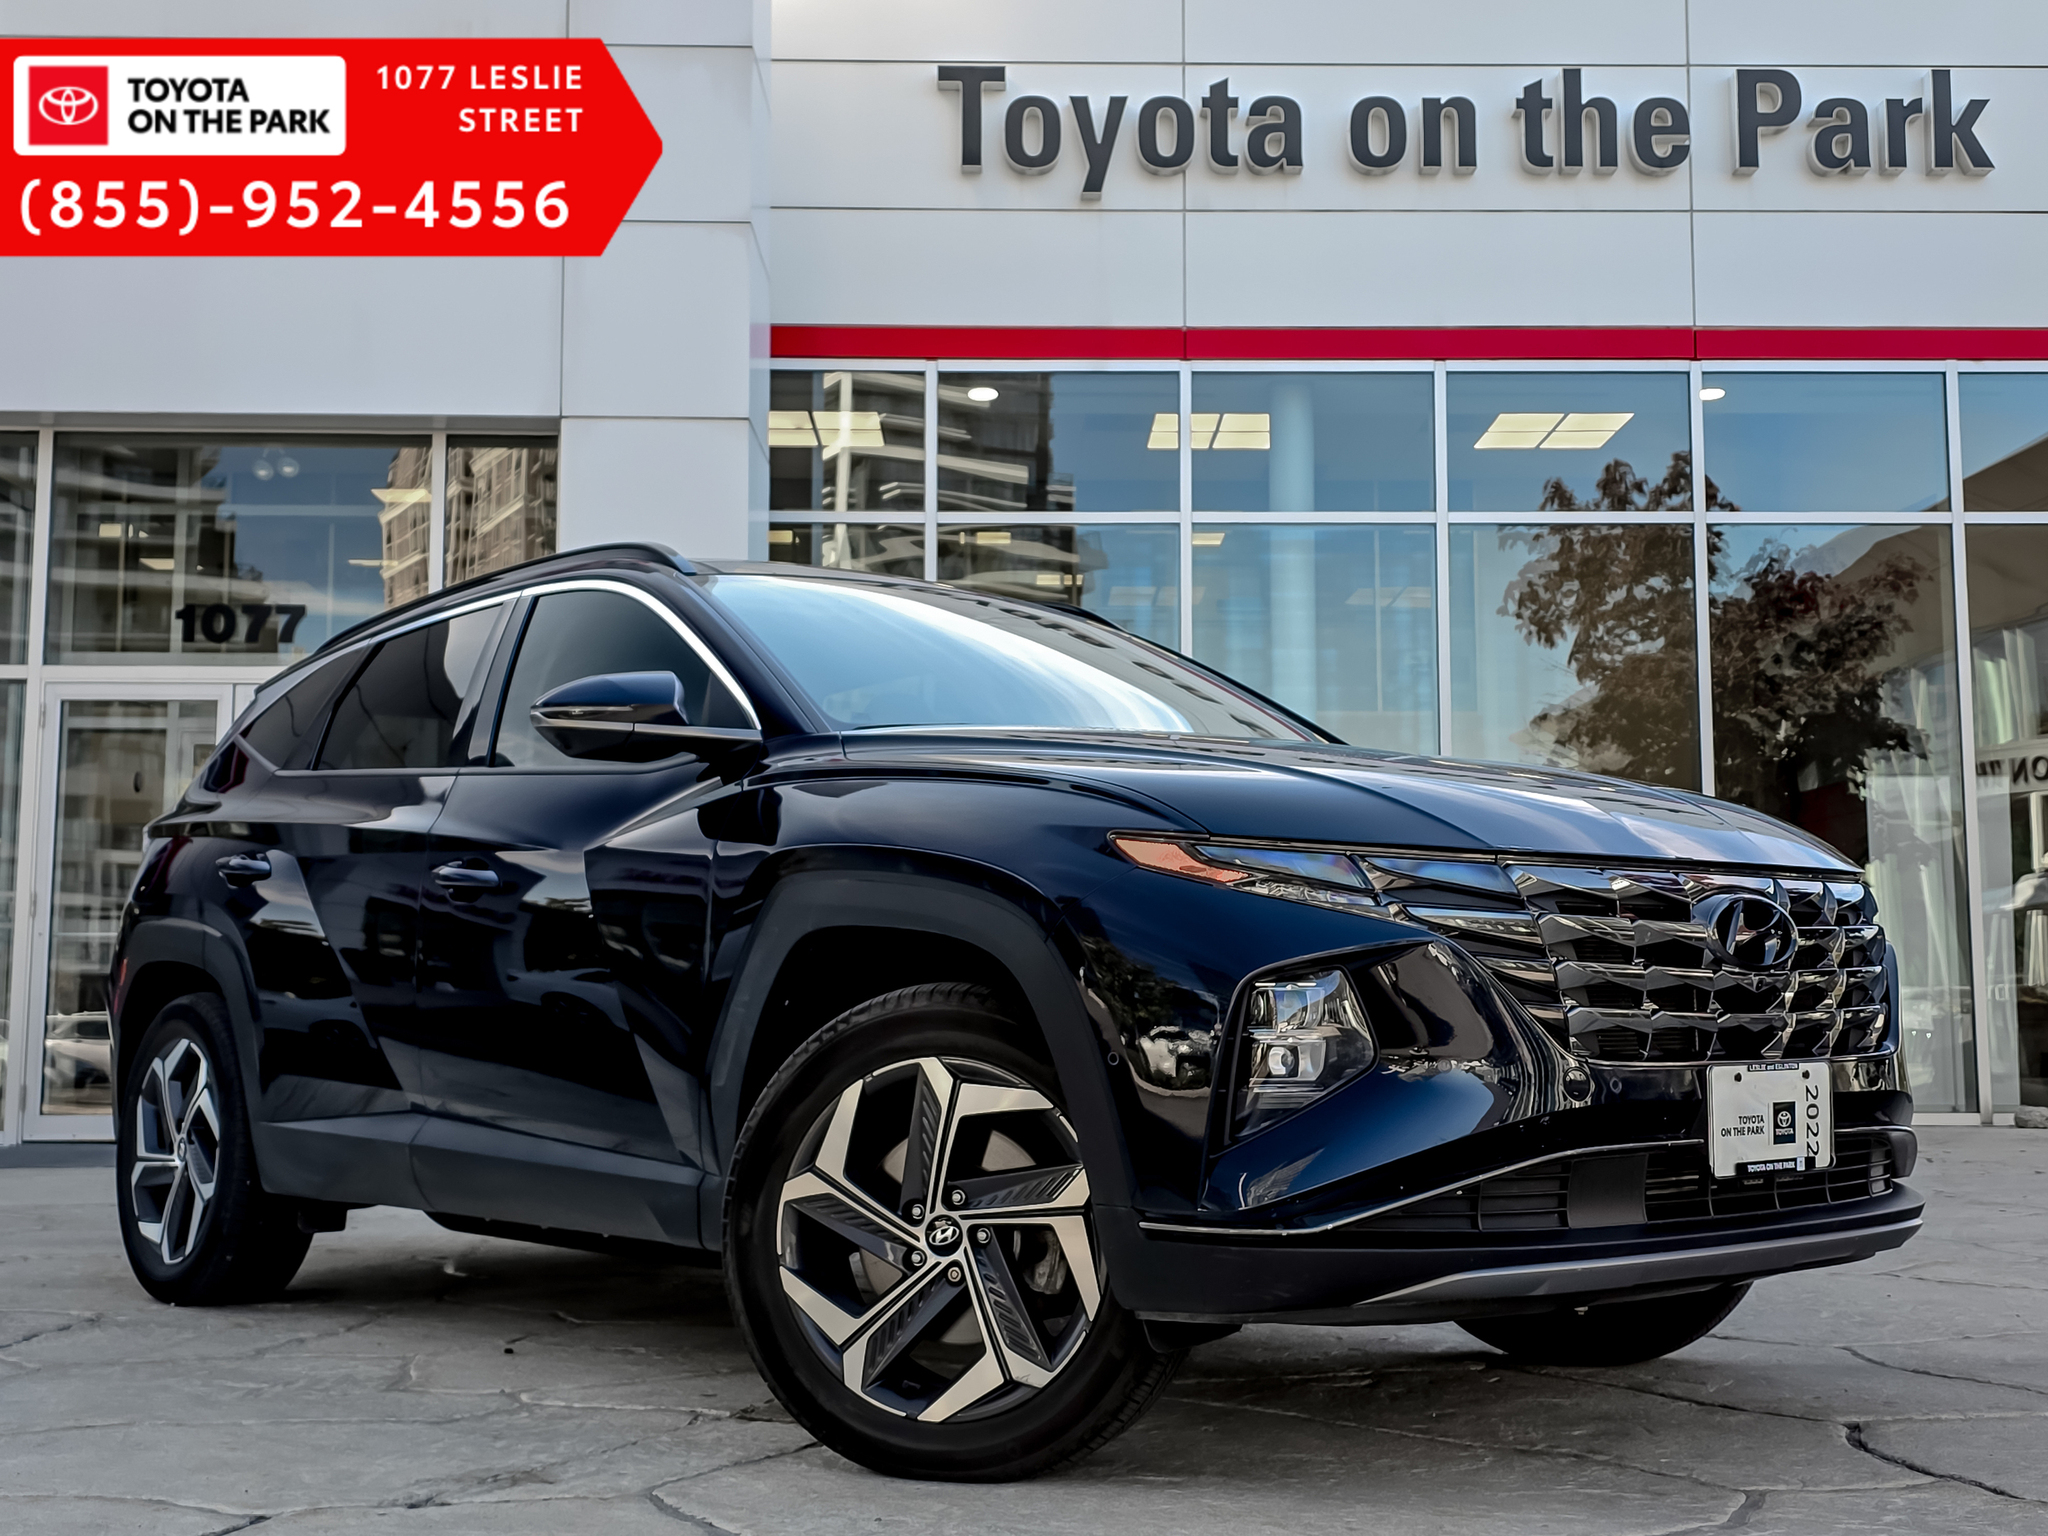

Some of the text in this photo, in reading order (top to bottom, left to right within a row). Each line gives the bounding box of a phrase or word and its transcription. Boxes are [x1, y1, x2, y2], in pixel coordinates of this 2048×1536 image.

[937, 65, 1996, 197] Toyota on the Park
[174, 603, 306, 644] 1077
[1738, 1114, 1765, 1125] TOYOTA
[1805, 1084, 1820, 1157] 2022
[1720, 1125, 1765, 1138] ON THE PARK
[1775, 1128, 1794, 1136] TOYOTA
[1747, 1163, 1766, 1172] TOYOTA
[1774, 1162, 1783, 1170] THE
[1783, 1161, 1796, 1169] PARK
